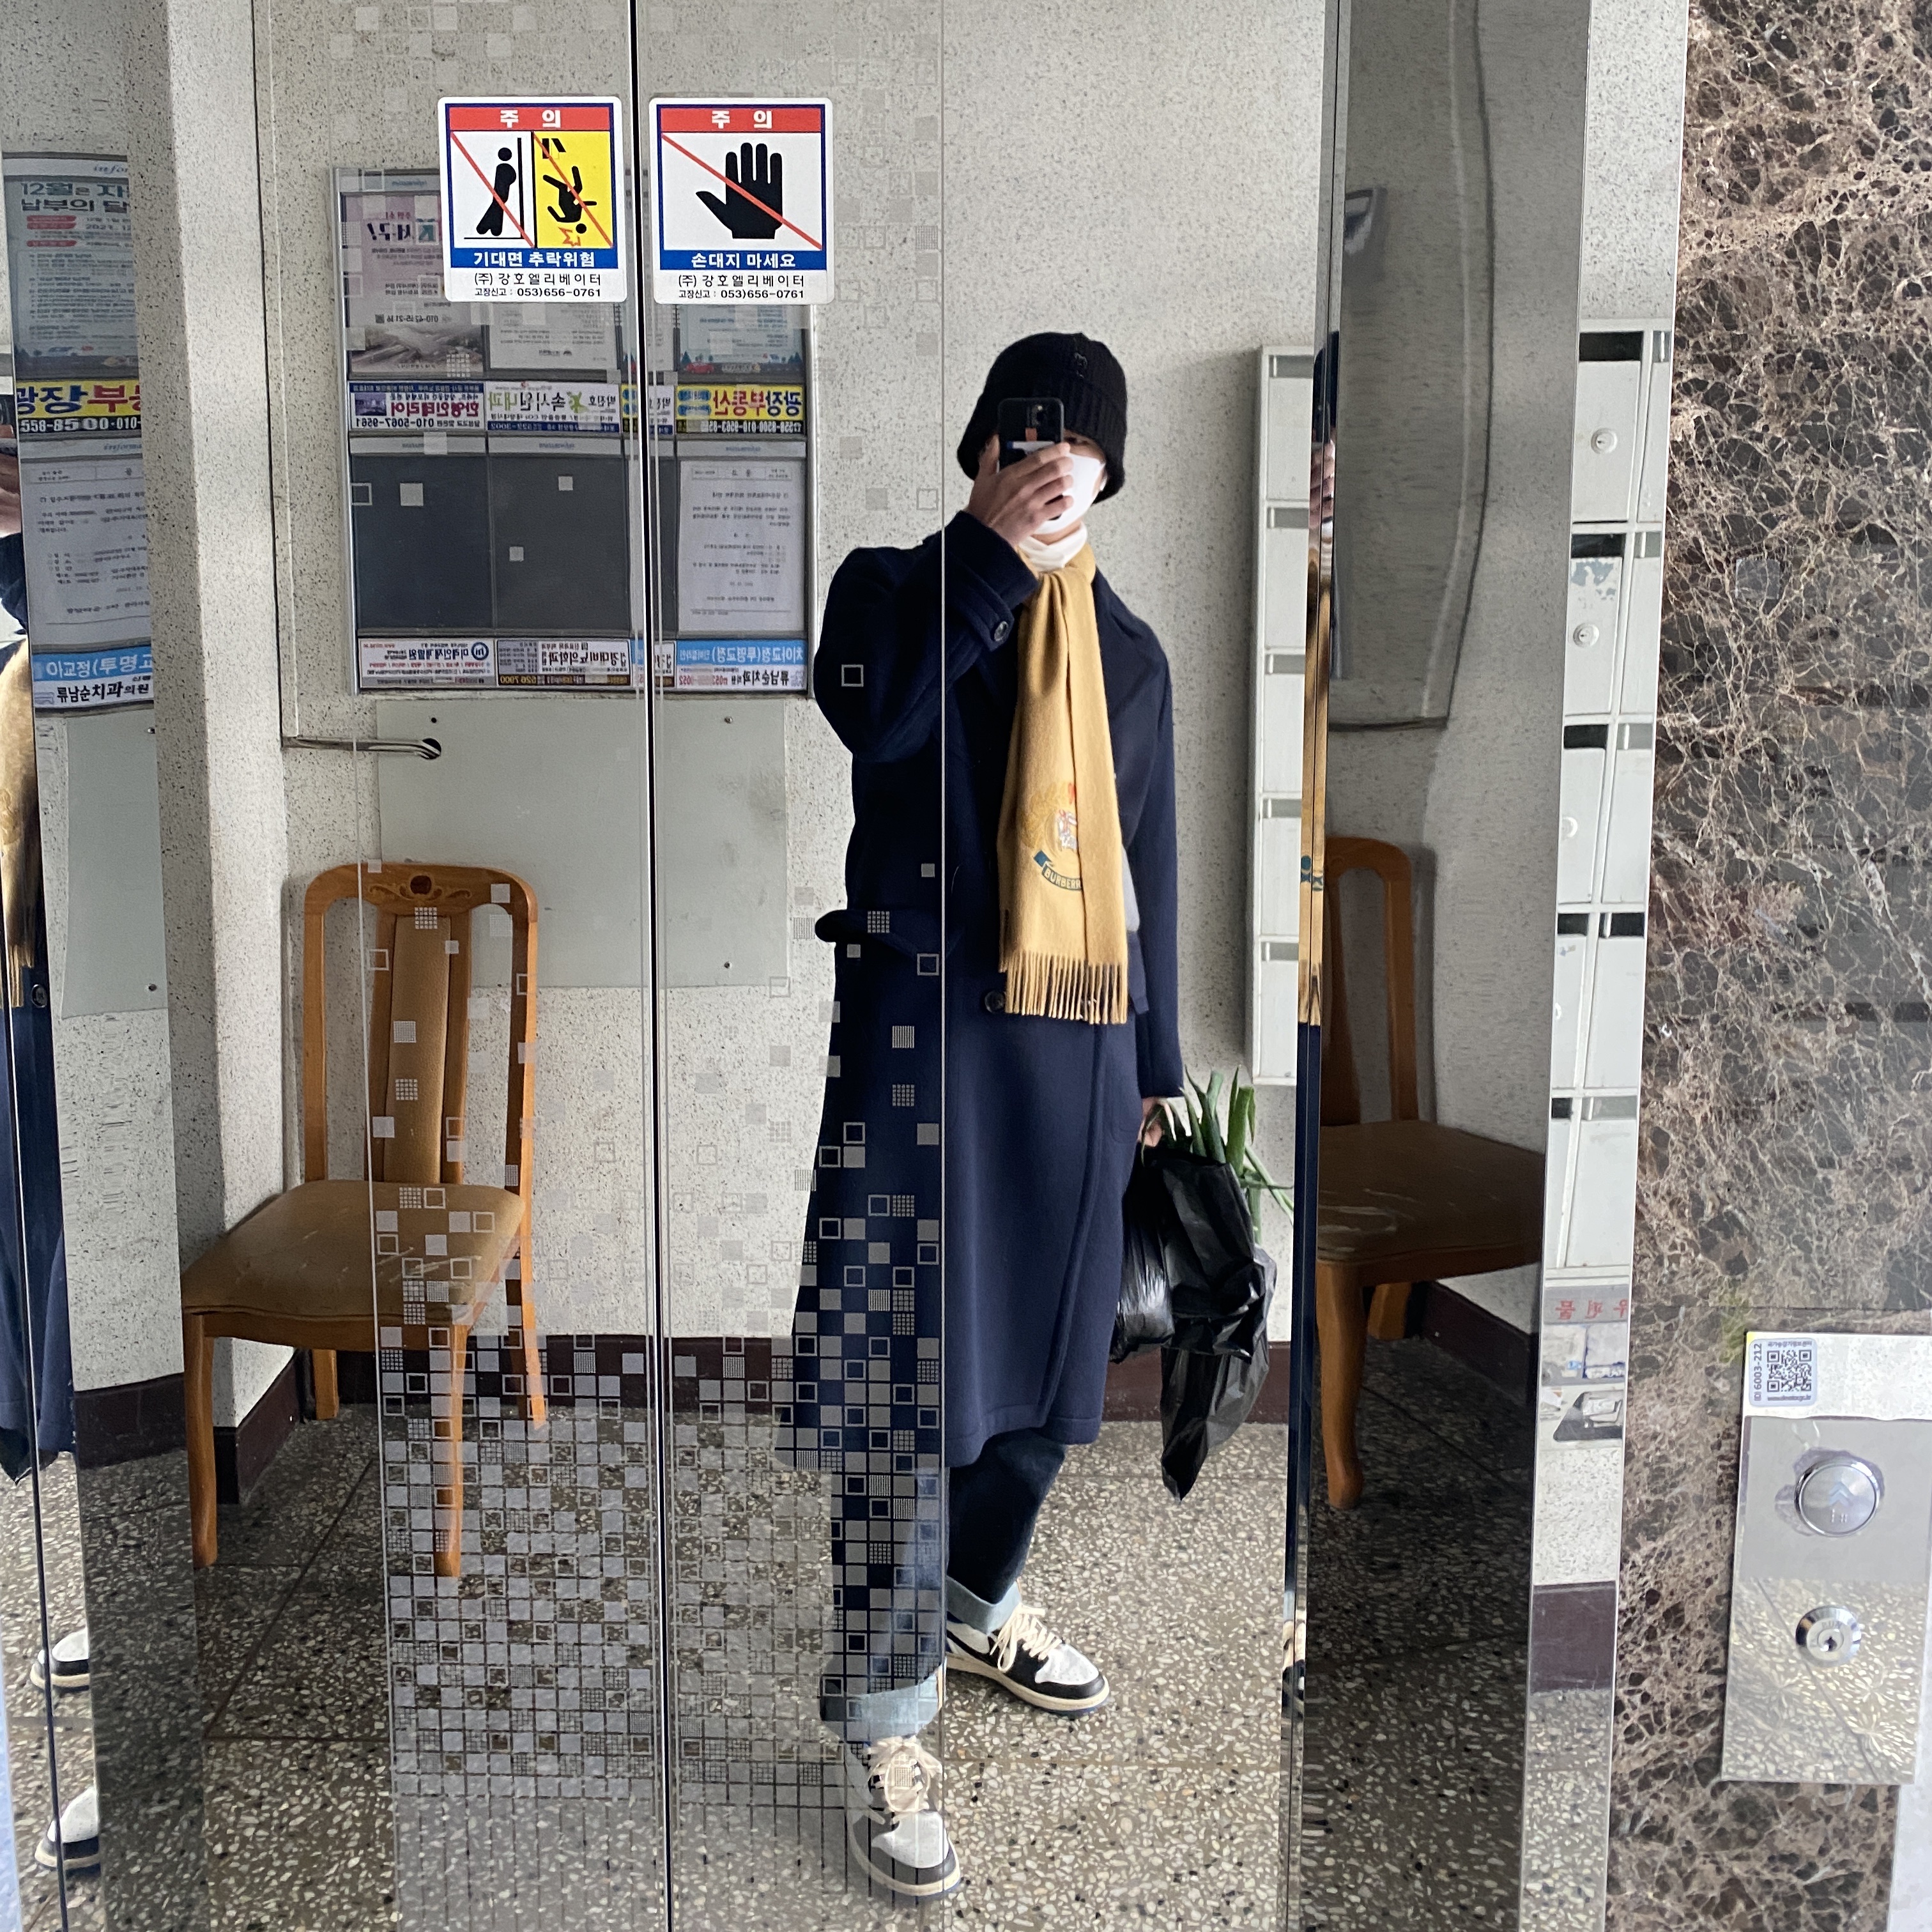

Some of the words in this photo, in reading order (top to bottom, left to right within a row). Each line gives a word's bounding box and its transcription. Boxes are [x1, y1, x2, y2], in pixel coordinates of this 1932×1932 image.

[97, 184, 129, 198] 자
[474, 251, 523, 267] 기대면
[528, 251, 595, 267] 추락위험
[691, 253, 740, 268] 손대지
[746, 253, 795, 269] 마세요
[475, 273, 493, 286] (주)
[678, 275, 696, 287] (주)
[517, 288, 601, 296] 053)656-0761
[721, 290, 804, 298] 053)656-0761
[1753, 1343, 1762, 1390] 6003-212
